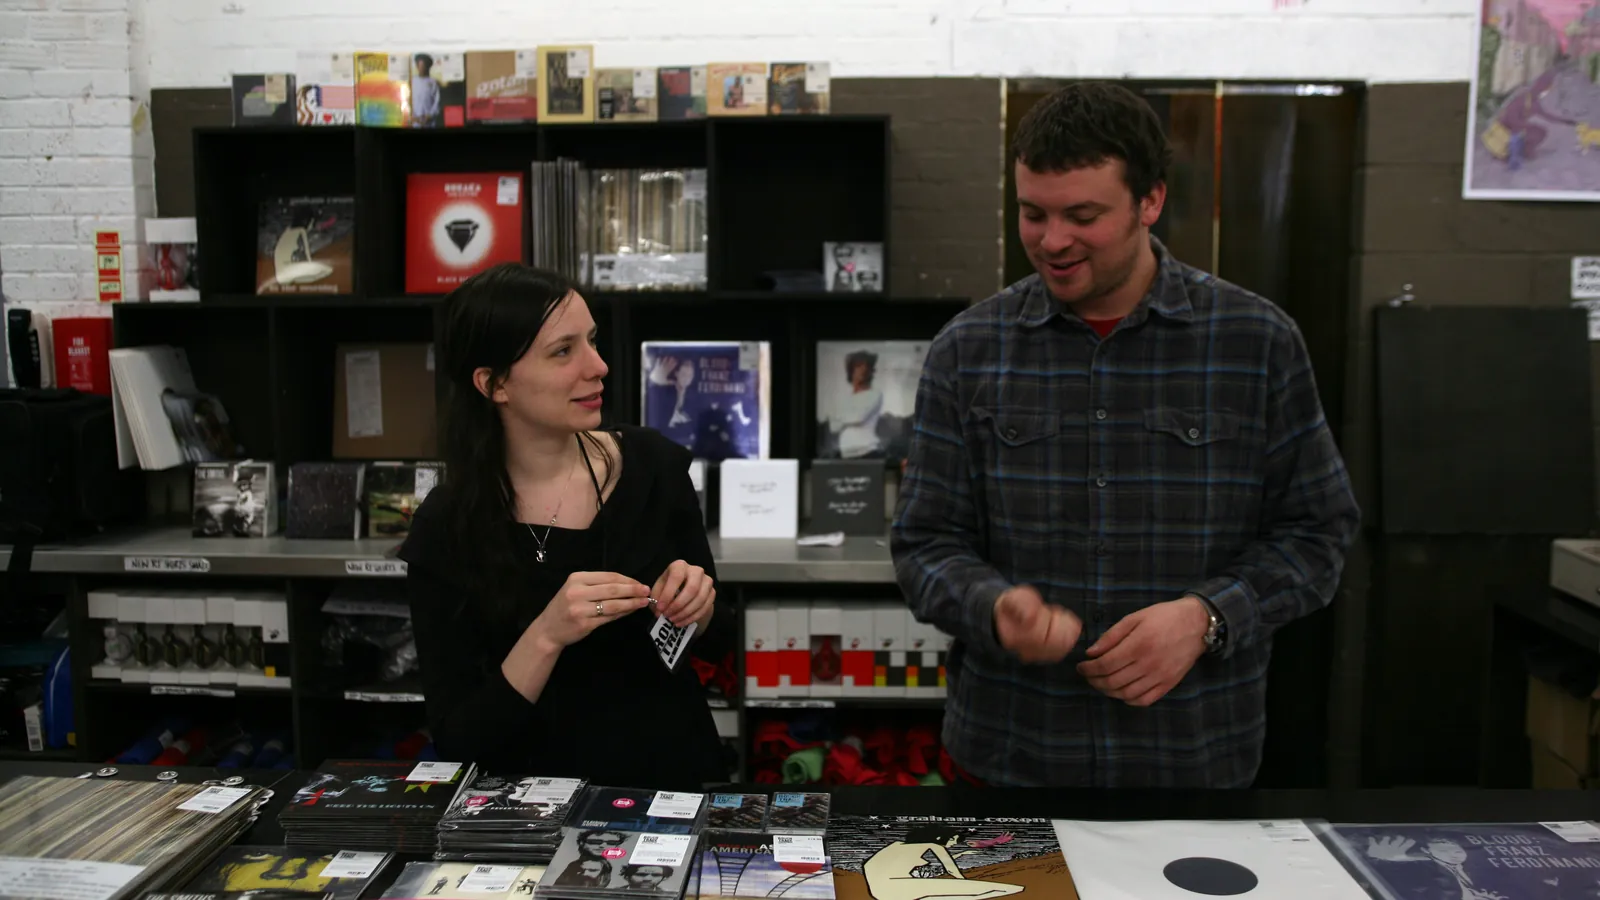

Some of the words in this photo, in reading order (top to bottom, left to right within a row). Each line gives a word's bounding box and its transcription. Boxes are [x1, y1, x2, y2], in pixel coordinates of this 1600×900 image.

[896, 815, 976, 823] graham
[1484, 845, 1551, 856] FRANZ
[1488, 856, 1600, 868] FERDINAND
